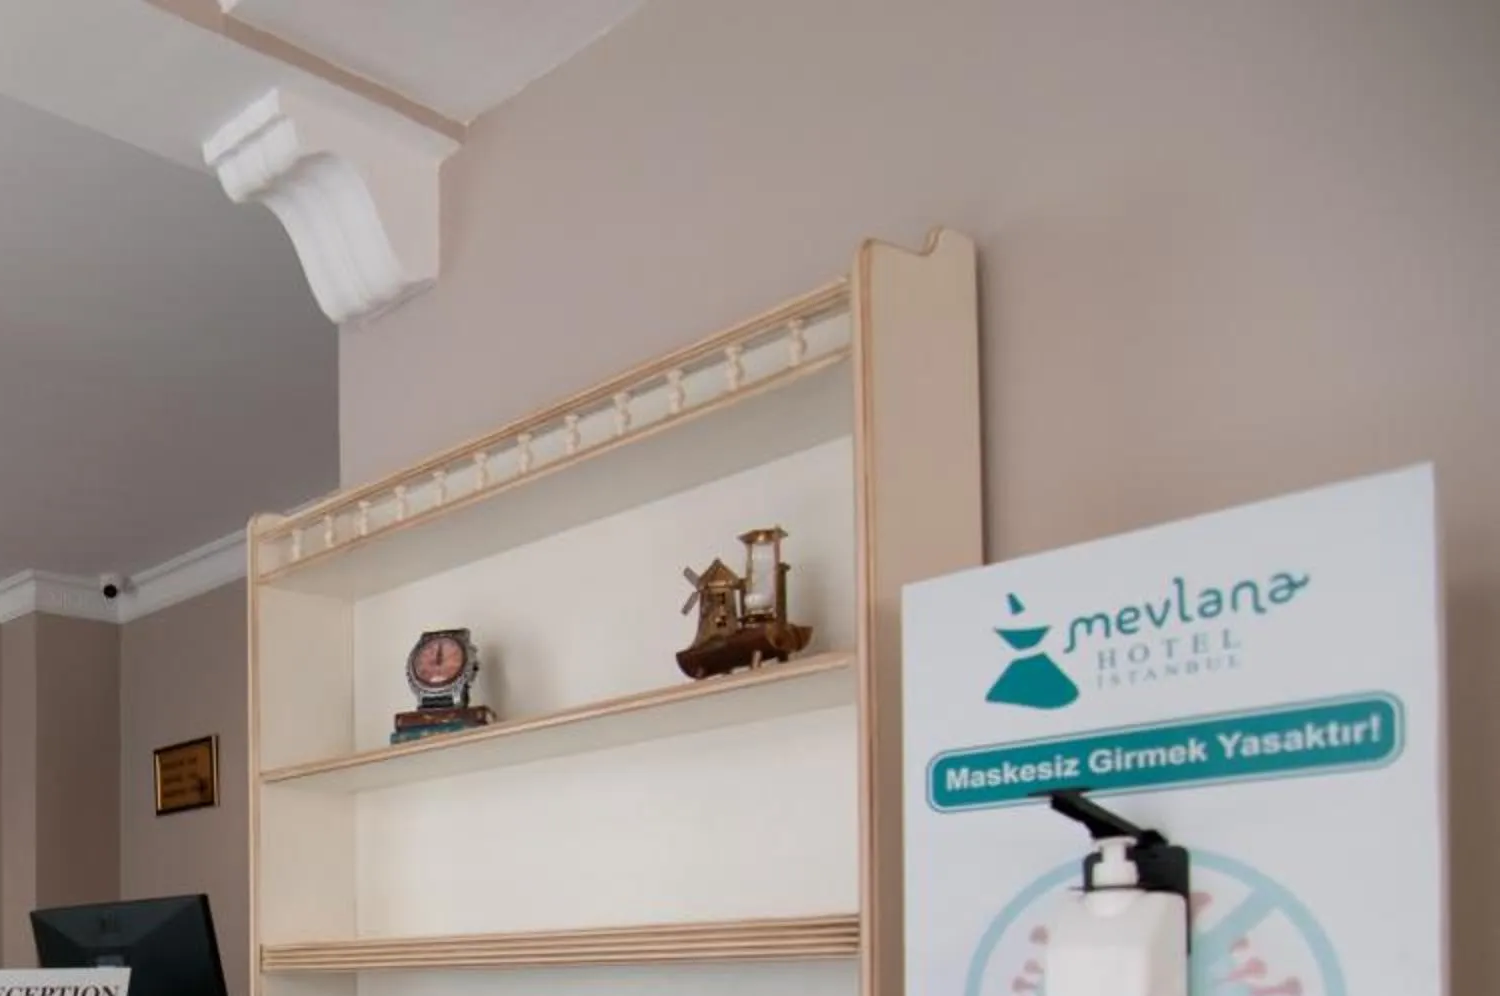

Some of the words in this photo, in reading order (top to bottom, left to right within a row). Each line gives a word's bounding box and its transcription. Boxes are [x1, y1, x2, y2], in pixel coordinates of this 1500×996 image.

[1063, 572, 1311, 654] mevlana
[1097, 627, 1241, 671] HOTEL
[945, 756, 1081, 791] Maskesiz
[1088, 739, 1208, 774] Girmek
[1217, 714, 1382, 760] Yasaktır!
